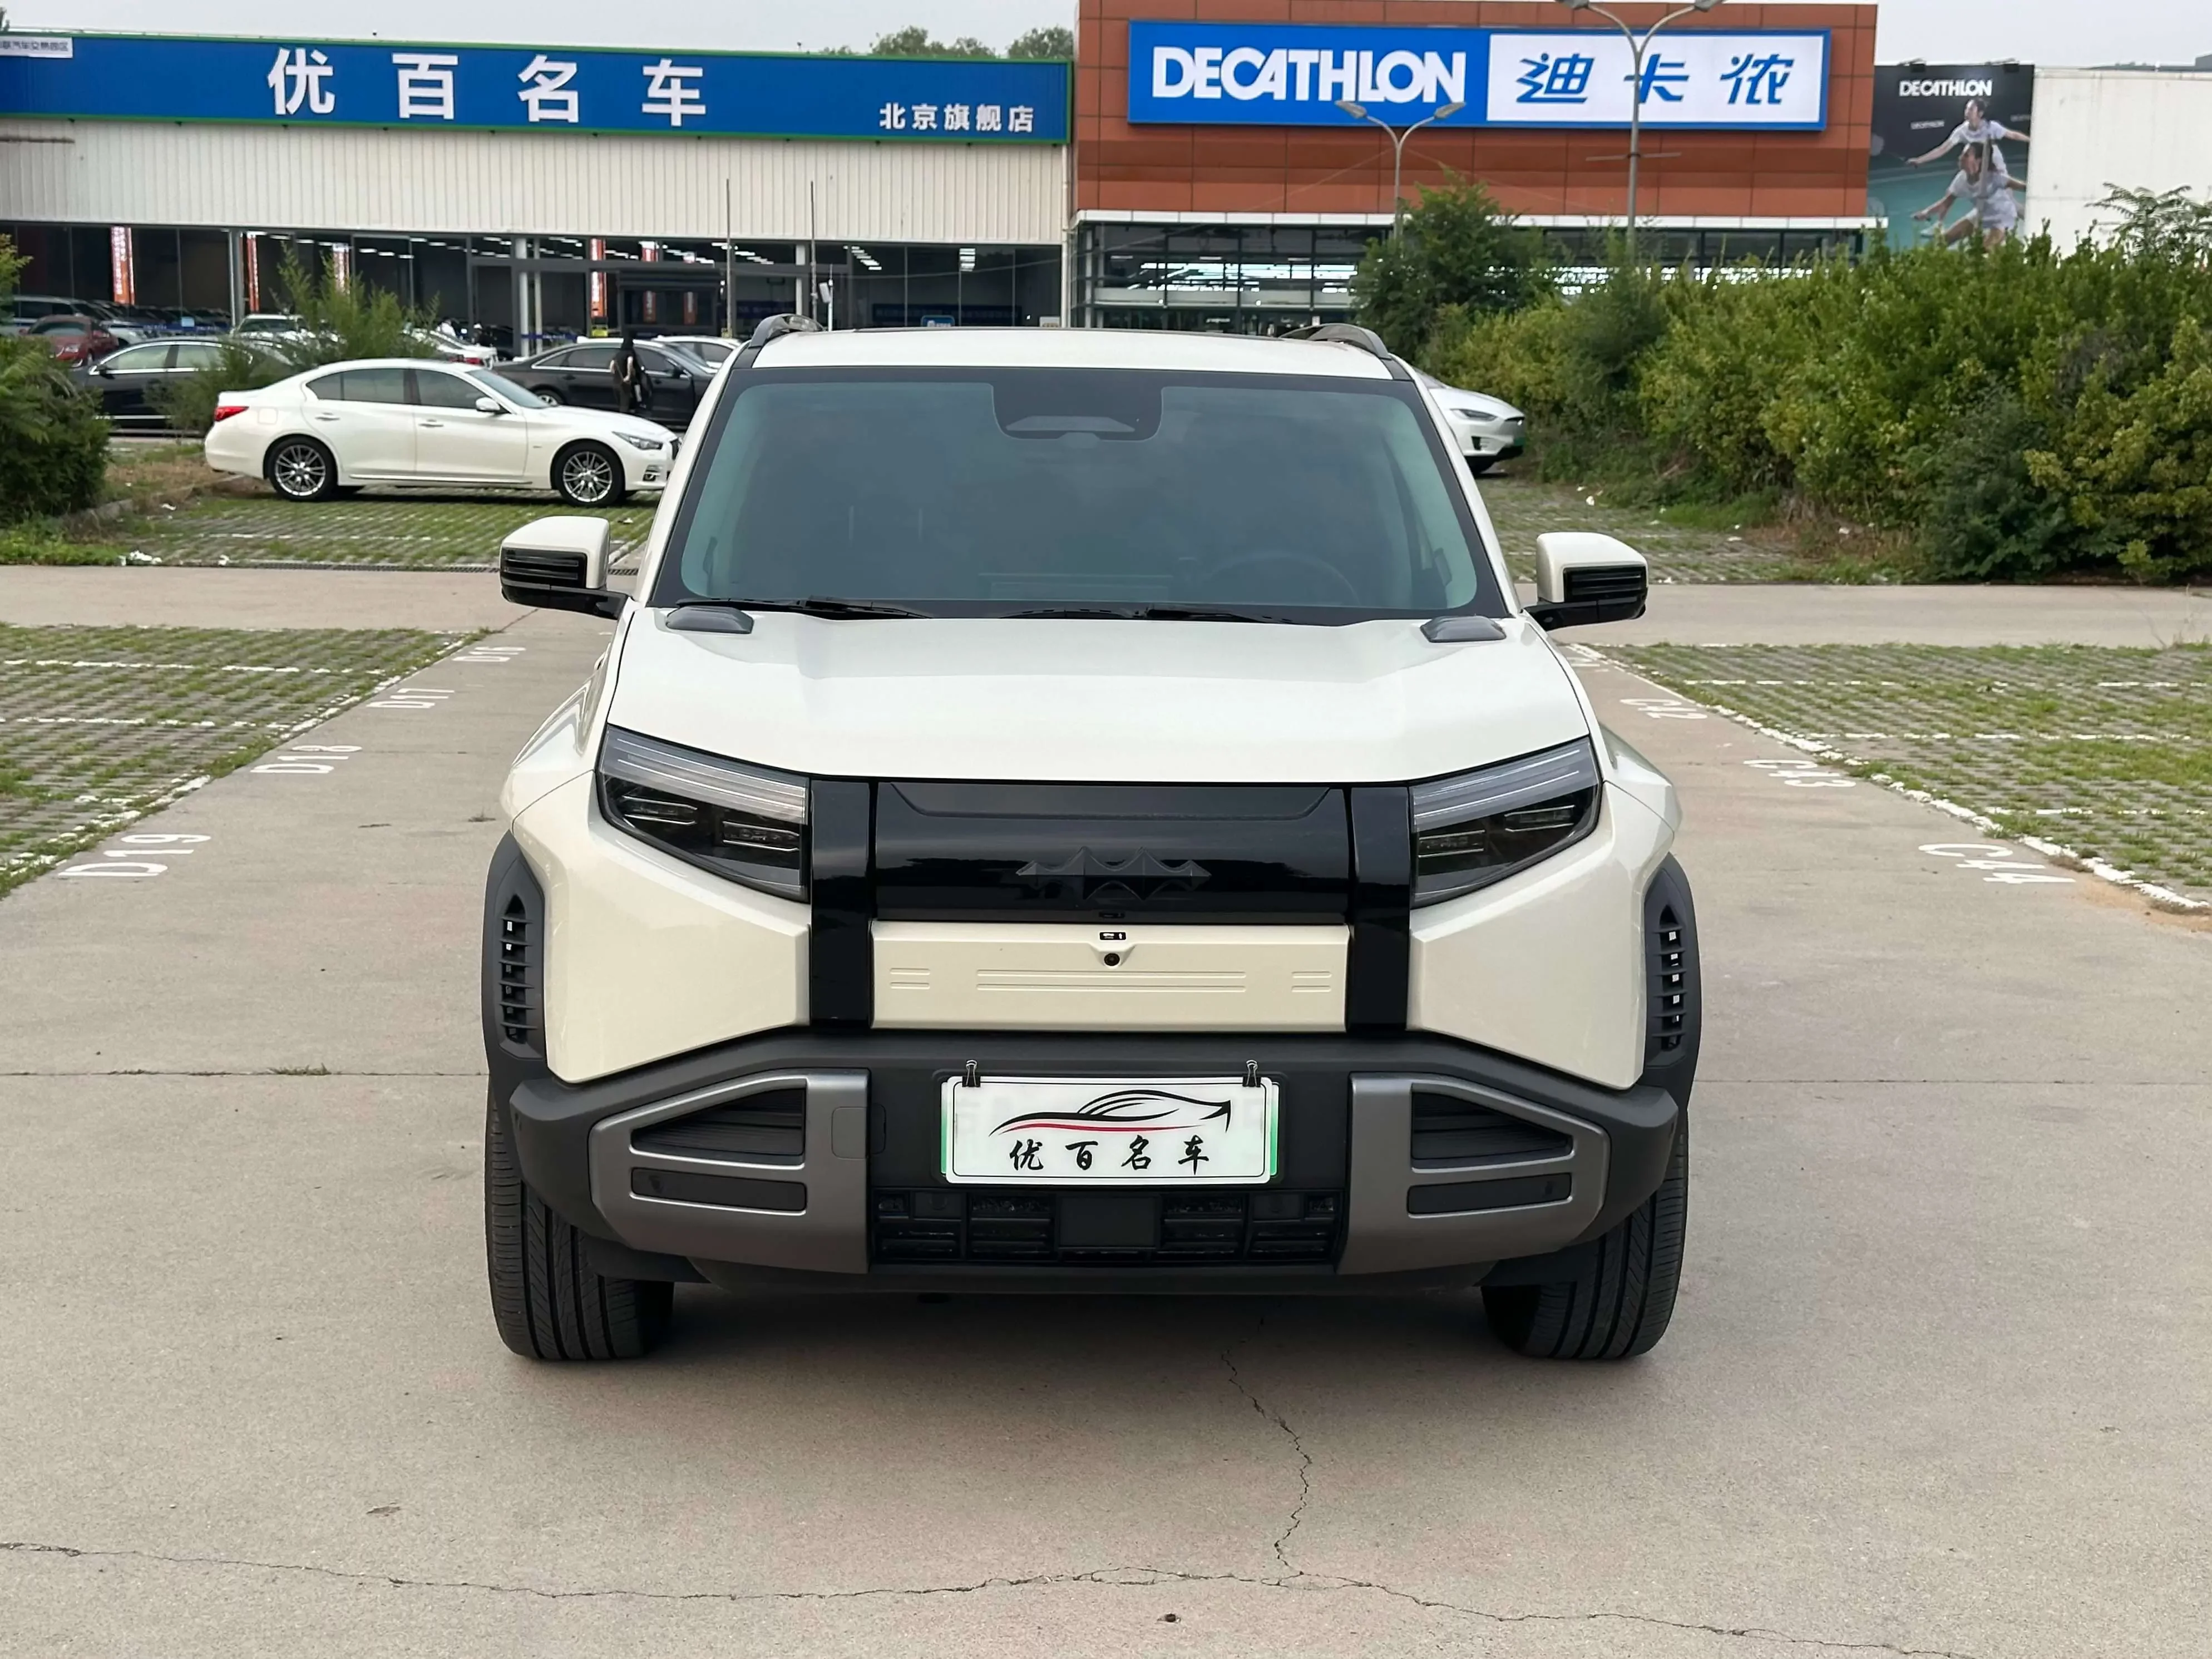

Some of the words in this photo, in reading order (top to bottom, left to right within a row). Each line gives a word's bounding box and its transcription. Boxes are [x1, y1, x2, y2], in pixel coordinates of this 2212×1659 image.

[268, 47, 705, 127] 优百名车
[1152, 47, 1466, 103] DECATHLON
[1516, 53, 1794, 105] 迪卡侬
[1899, 79, 1993, 97] DECATHLON
[880, 102, 1034, 132] 北京旗舰店
[452, 646, 526, 662] D16
[366, 688, 455, 708] D17
[1620, 699, 1707, 719] C42
[250, 745, 362, 773] D18
[1743, 759, 1857, 787] C43
[58, 834, 211, 876] D19
[1918, 843, 2076, 884] C44
[1009, 1134, 1209, 1175] 优百名车
